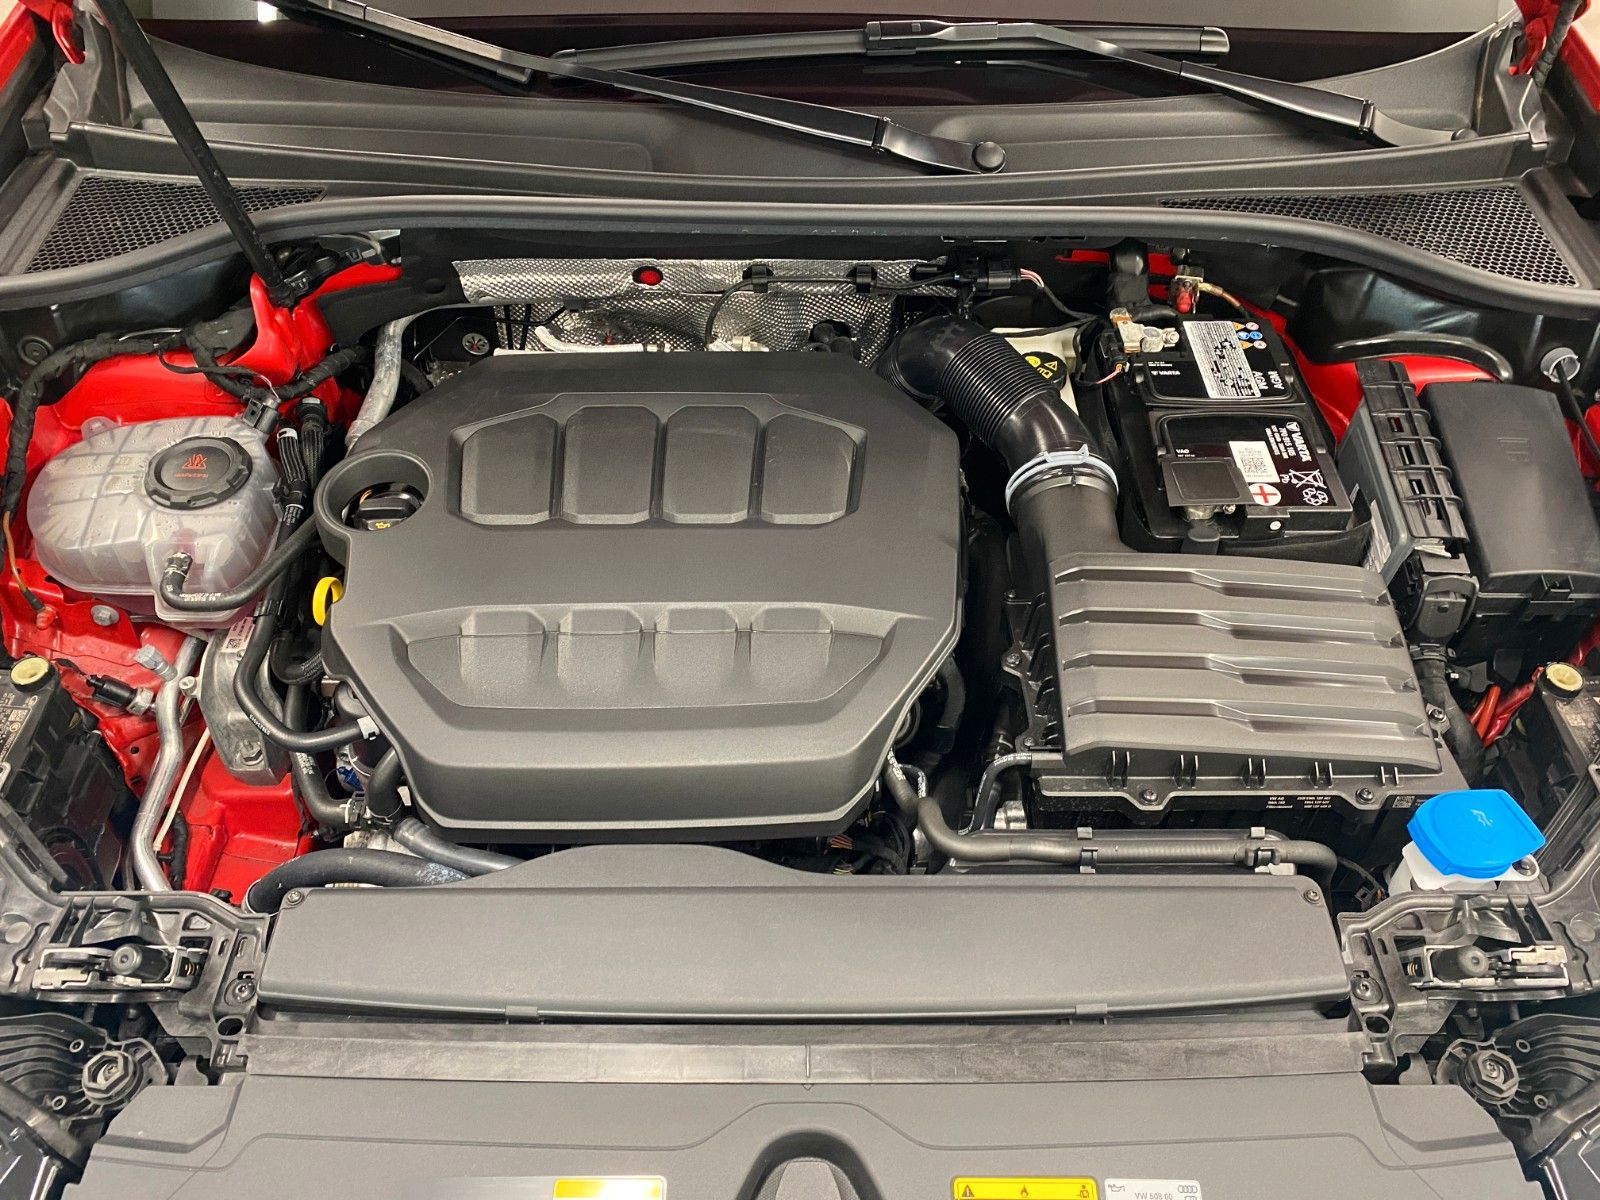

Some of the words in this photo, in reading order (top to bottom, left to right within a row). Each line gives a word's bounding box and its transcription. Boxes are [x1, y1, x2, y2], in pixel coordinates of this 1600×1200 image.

[1252, 371, 1269, 390] AGM
[1267, 371, 1285, 390] AGM
[1291, 431, 1312, 462] VARTA
